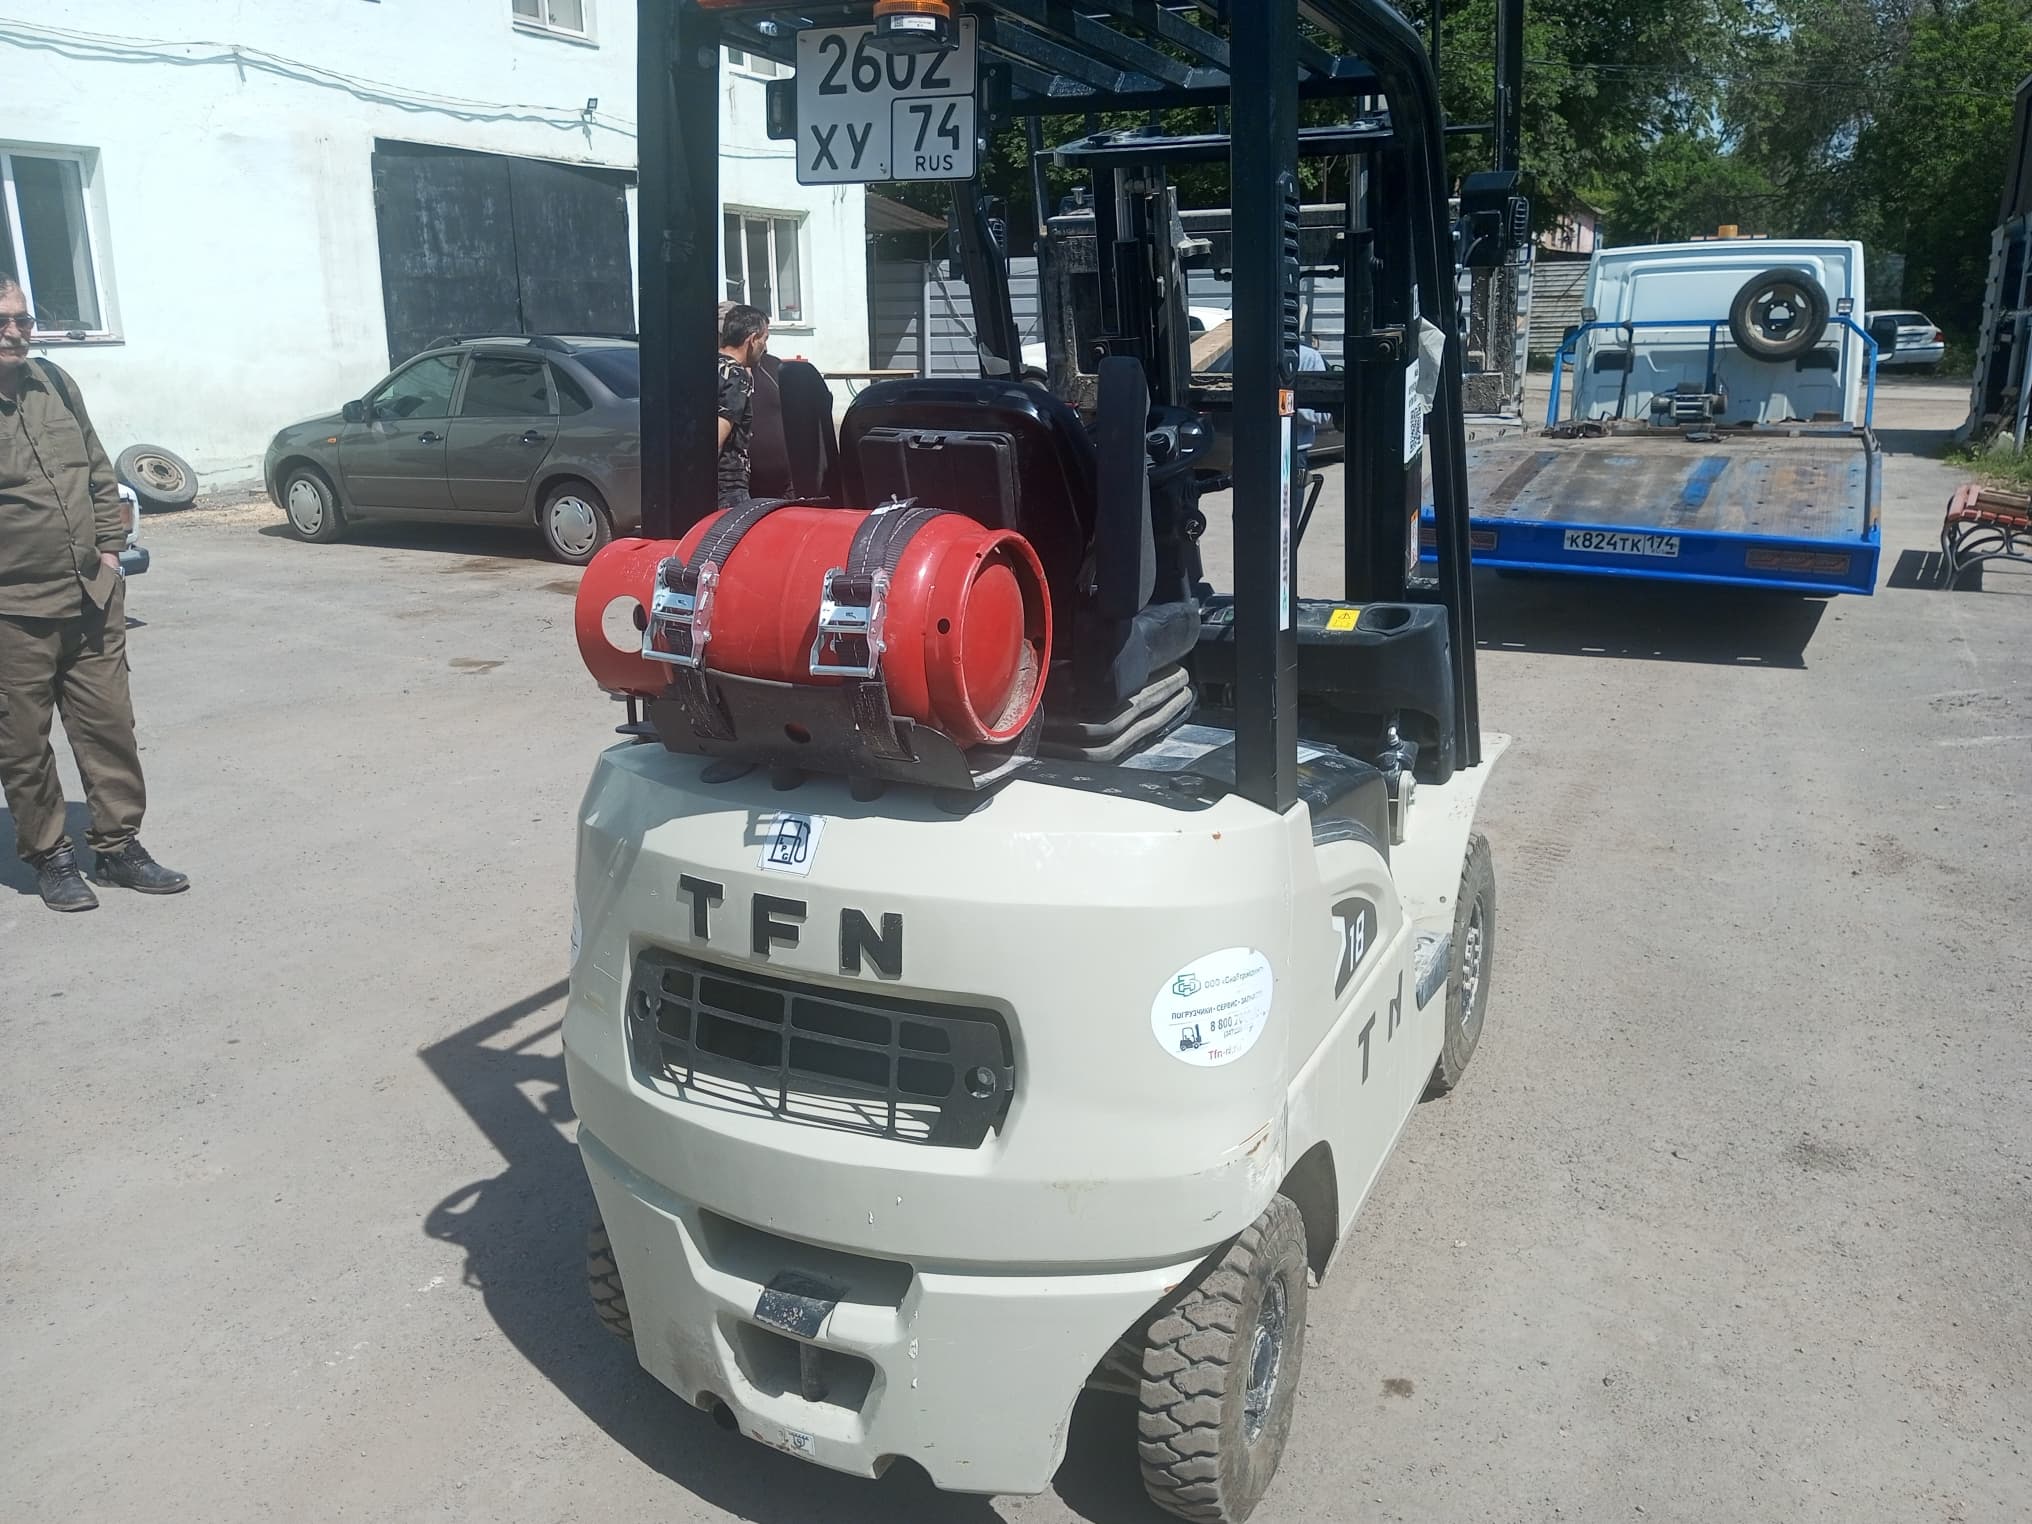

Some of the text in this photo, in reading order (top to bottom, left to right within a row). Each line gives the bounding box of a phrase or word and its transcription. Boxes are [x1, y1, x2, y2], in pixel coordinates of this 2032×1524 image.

[818, 32, 951, 96] 2602
[908, 102, 960, 152] 74
[915, 155, 953, 172] RUS
[1568, 532, 1675, 553] К824ТК 174
[680, 873, 903, 979] TFN
[1210, 1020, 1216, 1032] 8
[1218, 1016, 1233, 1031] 800
